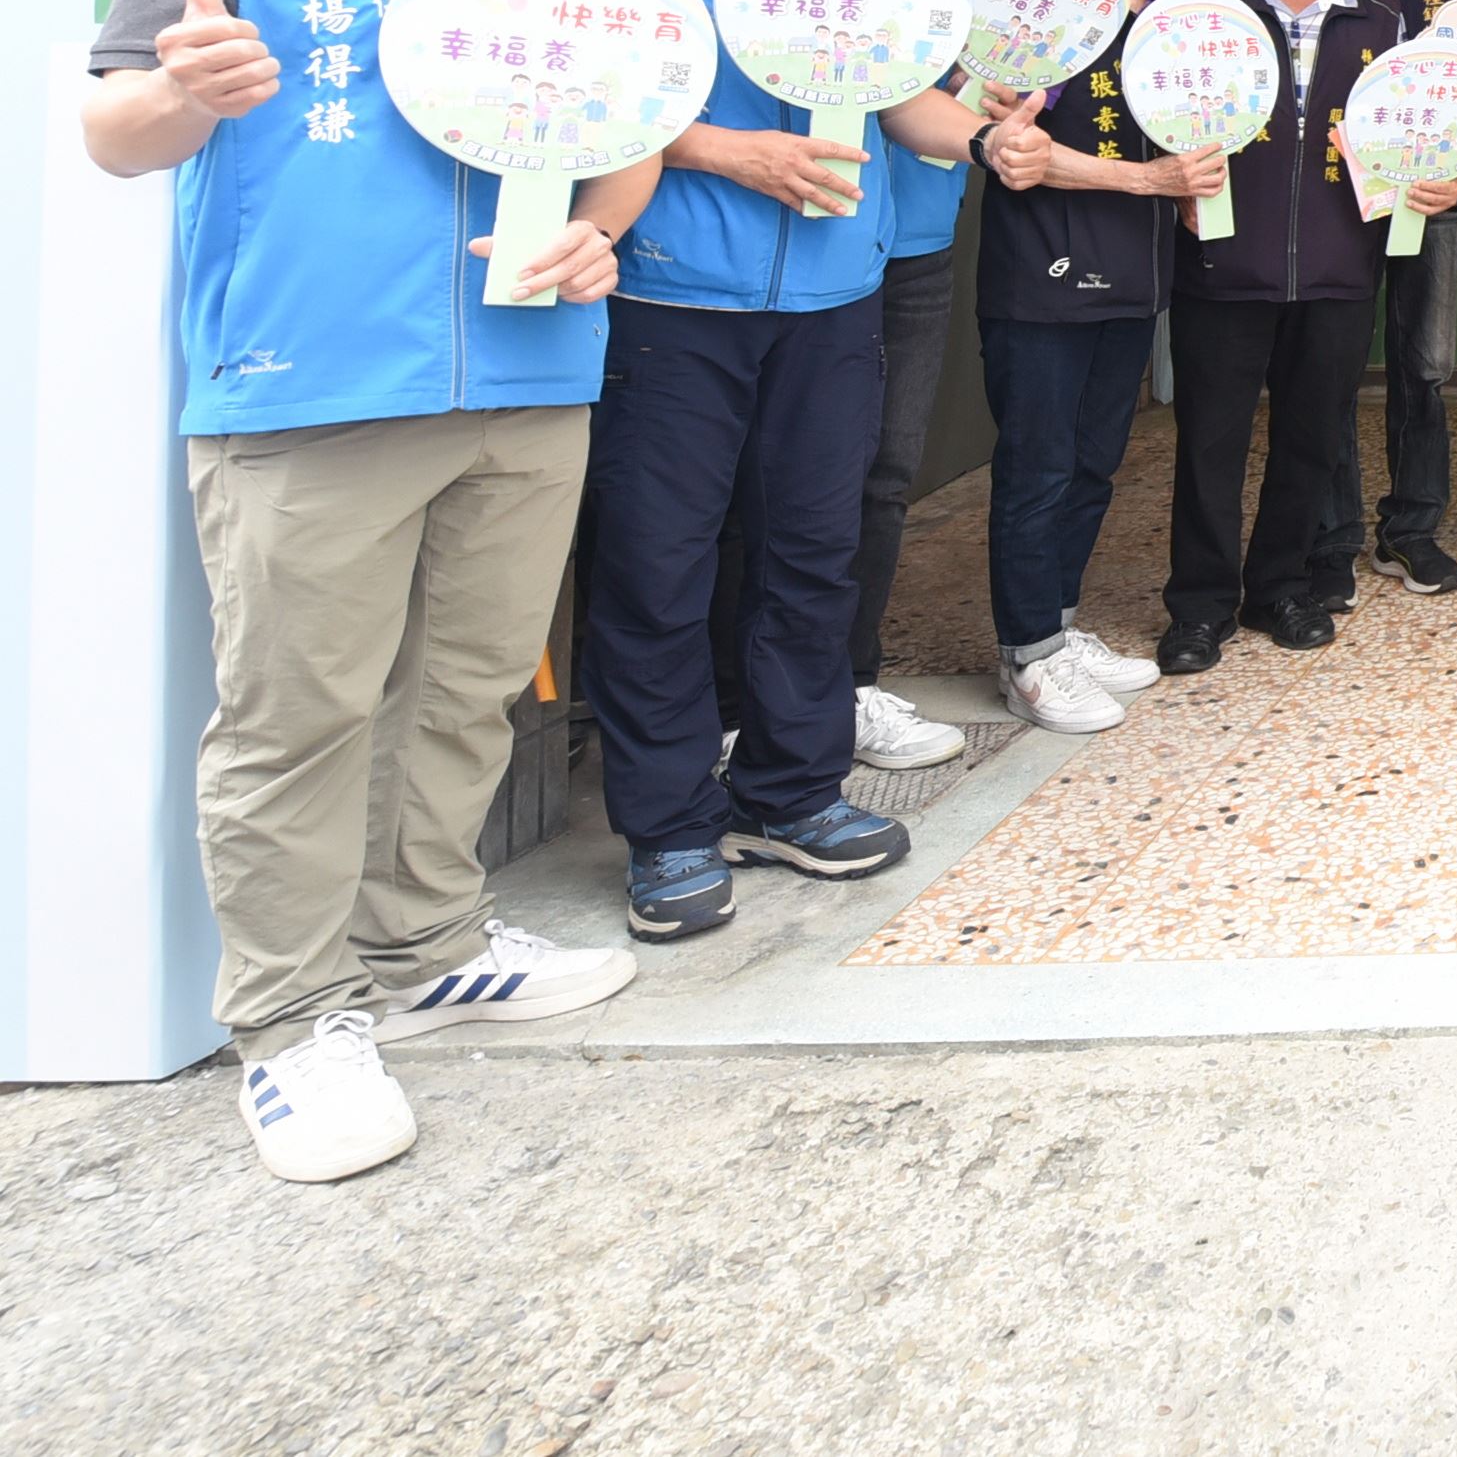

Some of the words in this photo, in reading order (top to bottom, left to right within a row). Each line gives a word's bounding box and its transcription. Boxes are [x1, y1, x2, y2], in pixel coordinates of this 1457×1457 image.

[1152, 12, 1224, 36] 安心生
[442, 28, 577, 71] 幸福養
[1198, 37, 1261, 60] 快樂育
[1151, 67, 1216, 91] 幸福養
[1374, 106, 1437, 126] 幸福養
[1324, 108, 1344, 183] 服團隊
